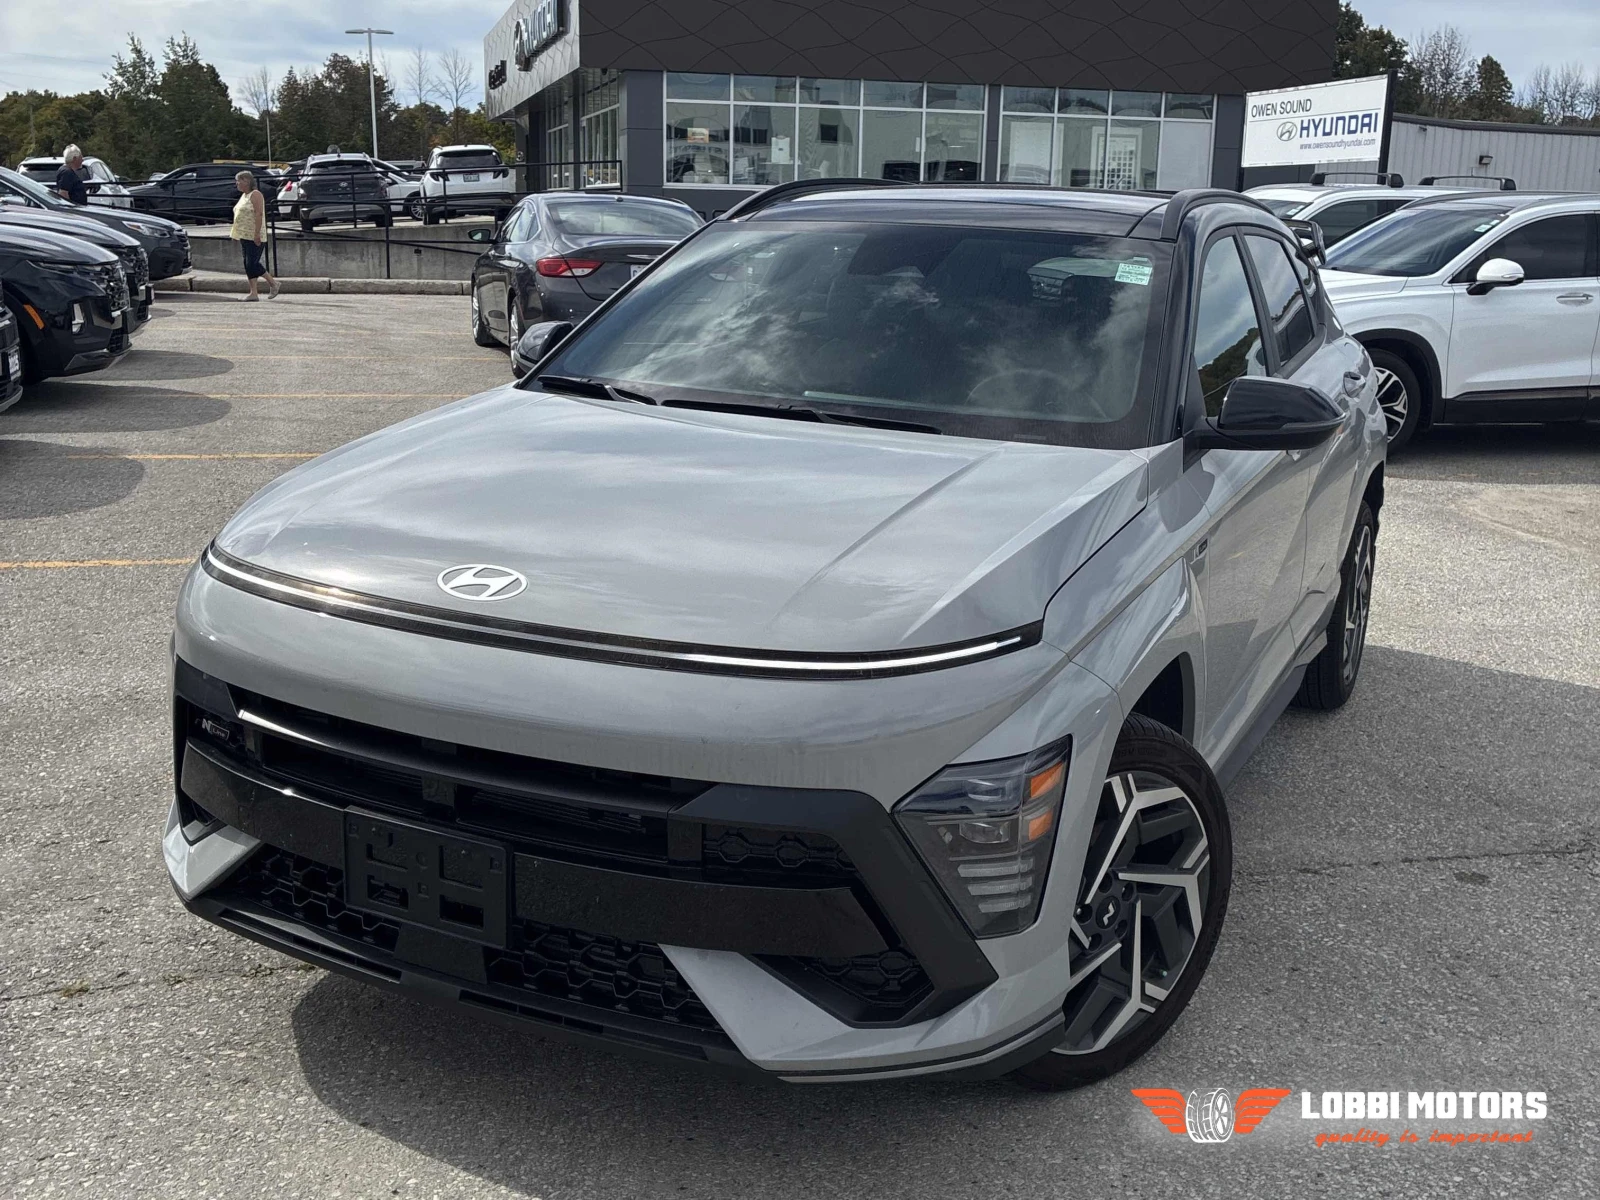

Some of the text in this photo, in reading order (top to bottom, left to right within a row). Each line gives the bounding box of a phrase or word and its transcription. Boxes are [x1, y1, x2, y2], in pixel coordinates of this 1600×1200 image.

[1251, 98, 1312, 118] OWEN SOUND
[1299, 112, 1379, 138] HYUNDAI
